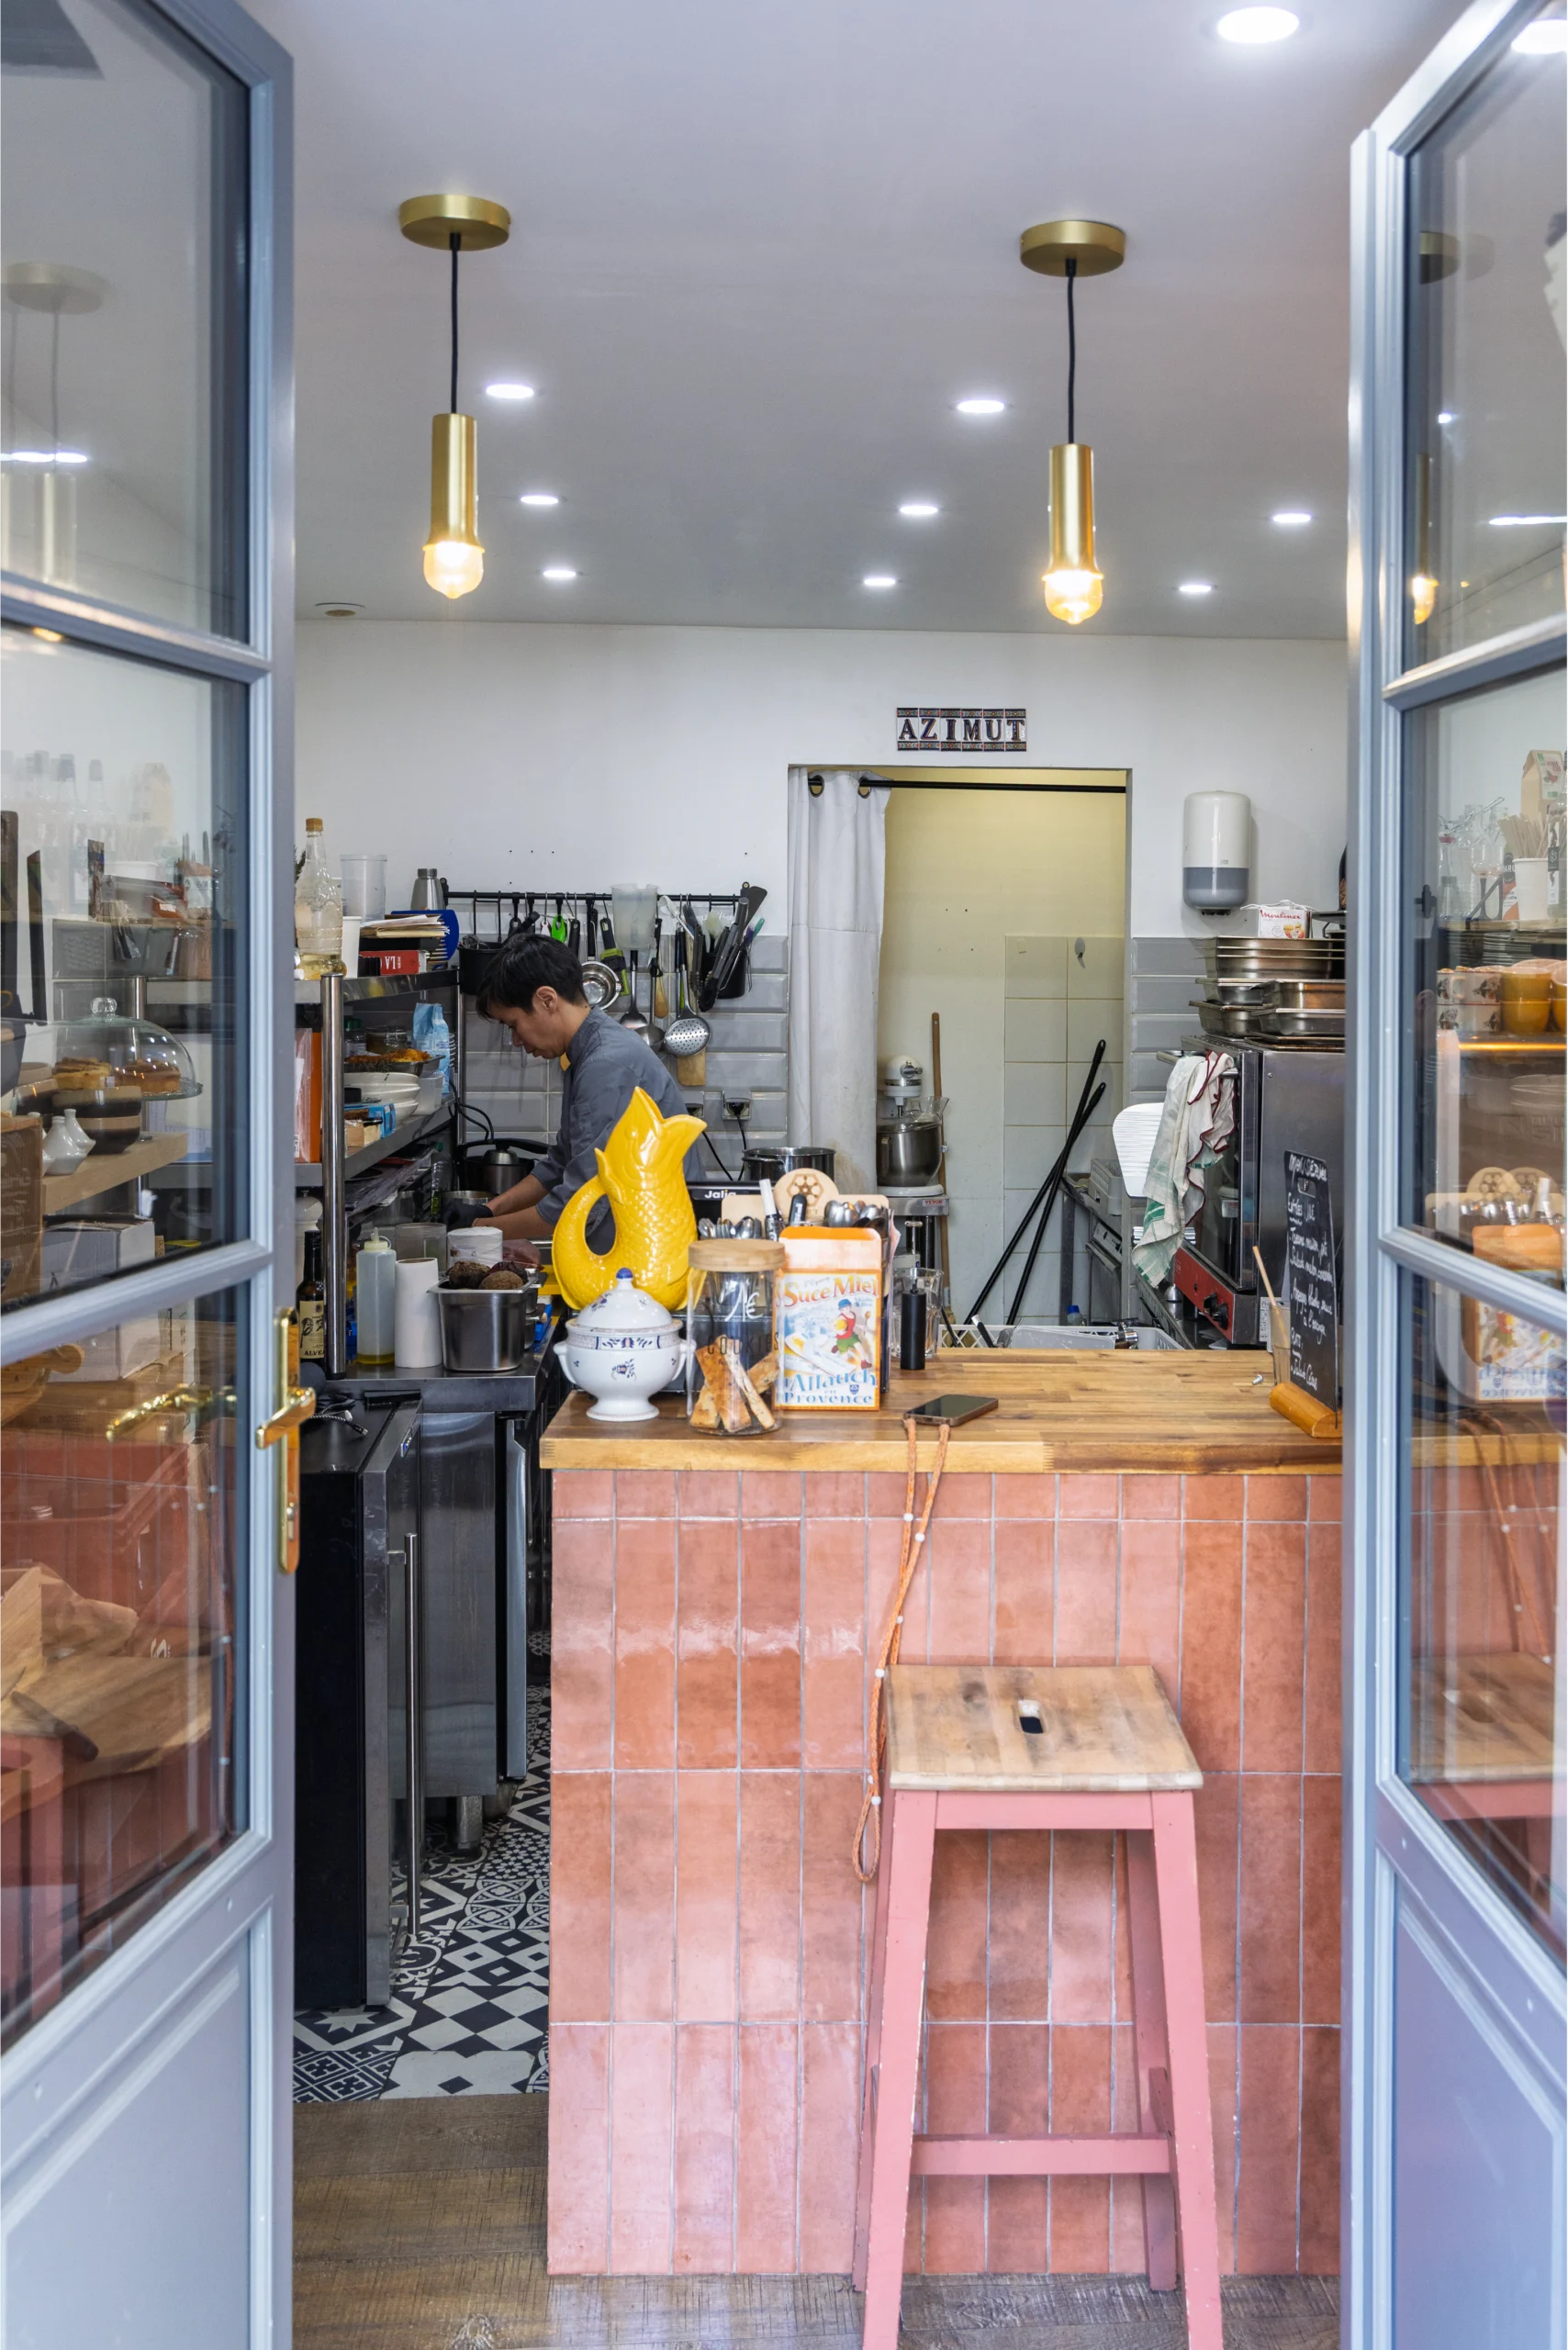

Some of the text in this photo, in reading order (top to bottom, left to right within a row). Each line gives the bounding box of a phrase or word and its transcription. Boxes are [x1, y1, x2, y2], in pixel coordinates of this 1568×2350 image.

[899, 719, 1025, 742] AZIMUT
[1260, 910, 1301, 919] Moulinex
[783, 1281, 832, 1308] Suce
[833, 1274, 879, 1298] Miel
[708, 1332, 779, 1355] COOKIES
[784, 1392, 872, 1404] Provence
